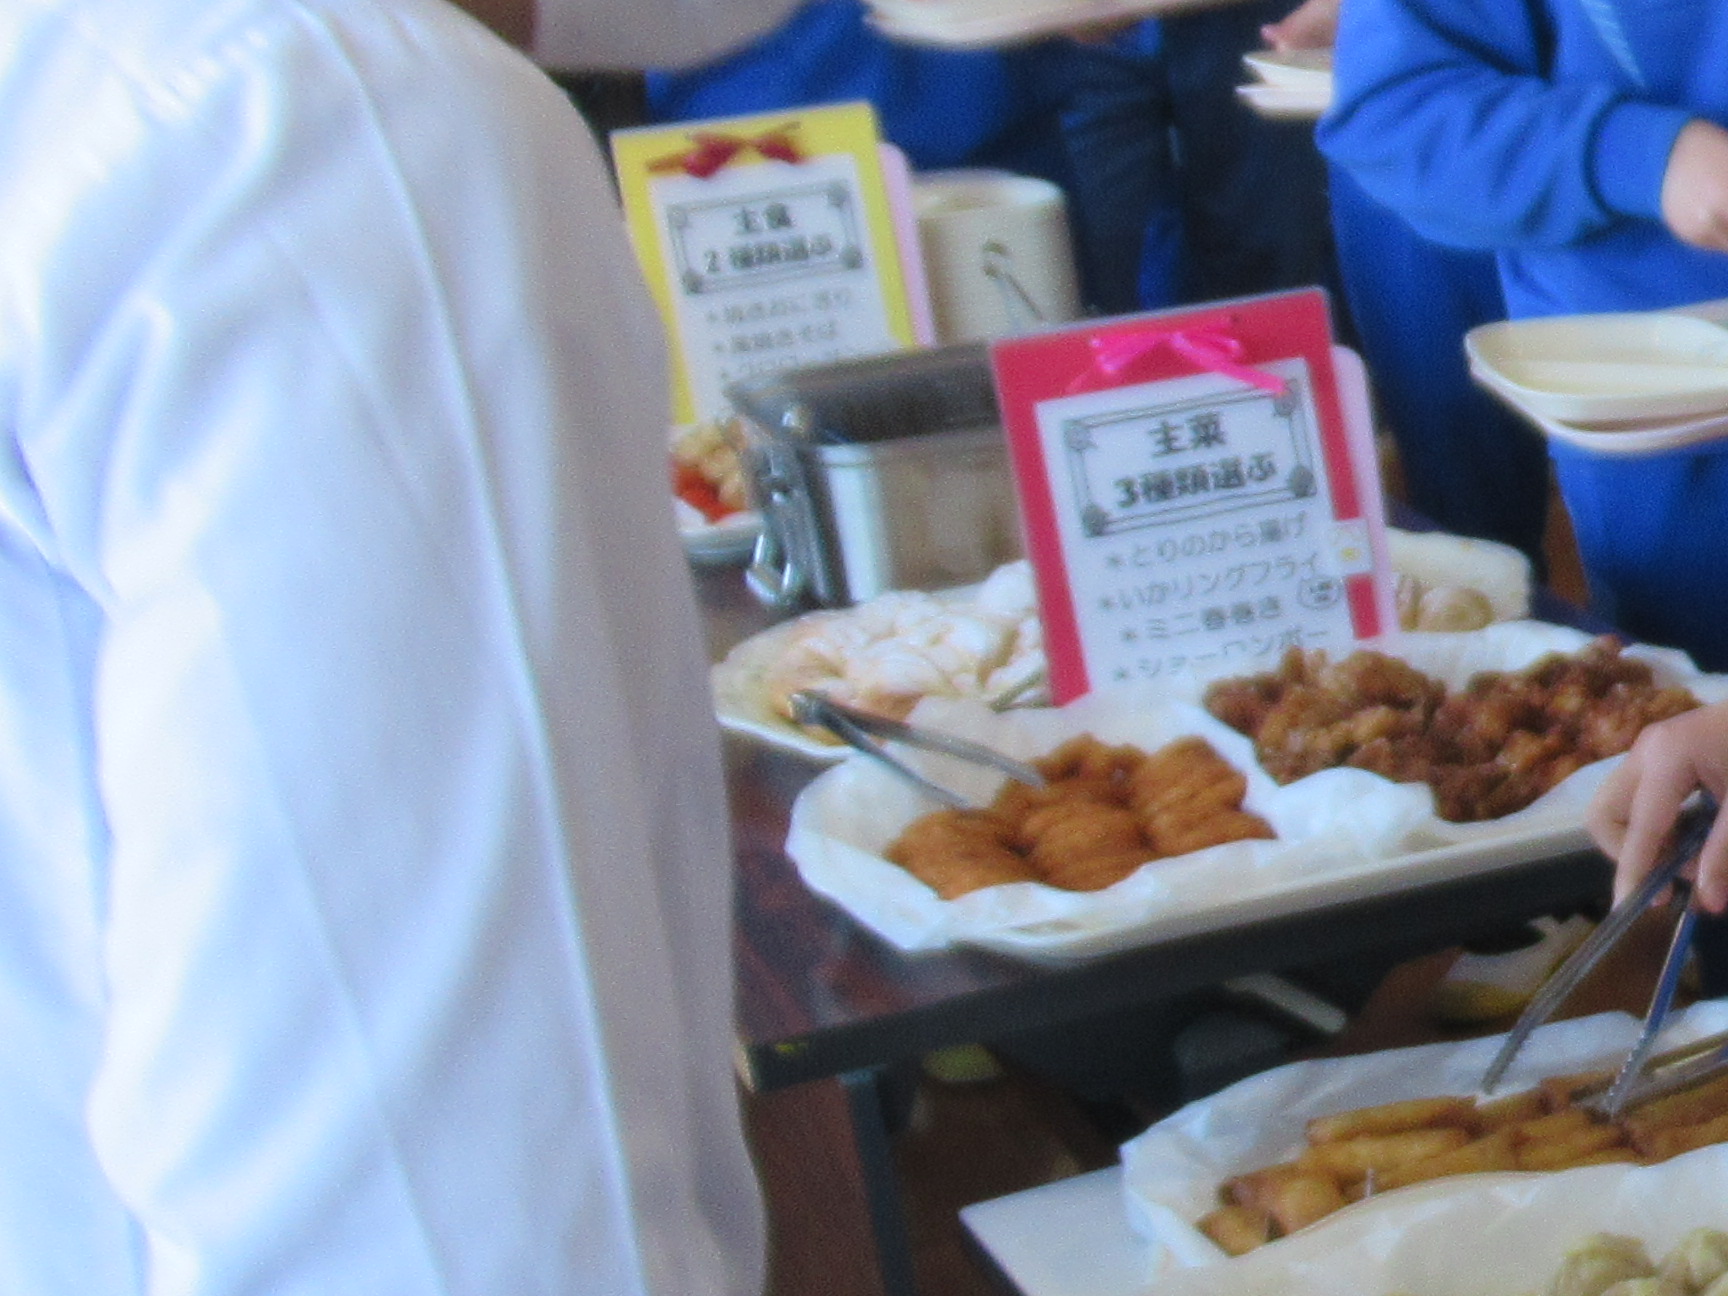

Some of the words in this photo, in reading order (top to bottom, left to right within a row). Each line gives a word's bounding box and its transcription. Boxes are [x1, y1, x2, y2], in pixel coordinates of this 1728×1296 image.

[1149, 411, 1226, 457] 主菜
[1113, 452, 1277, 507] 3種類選ぶ
